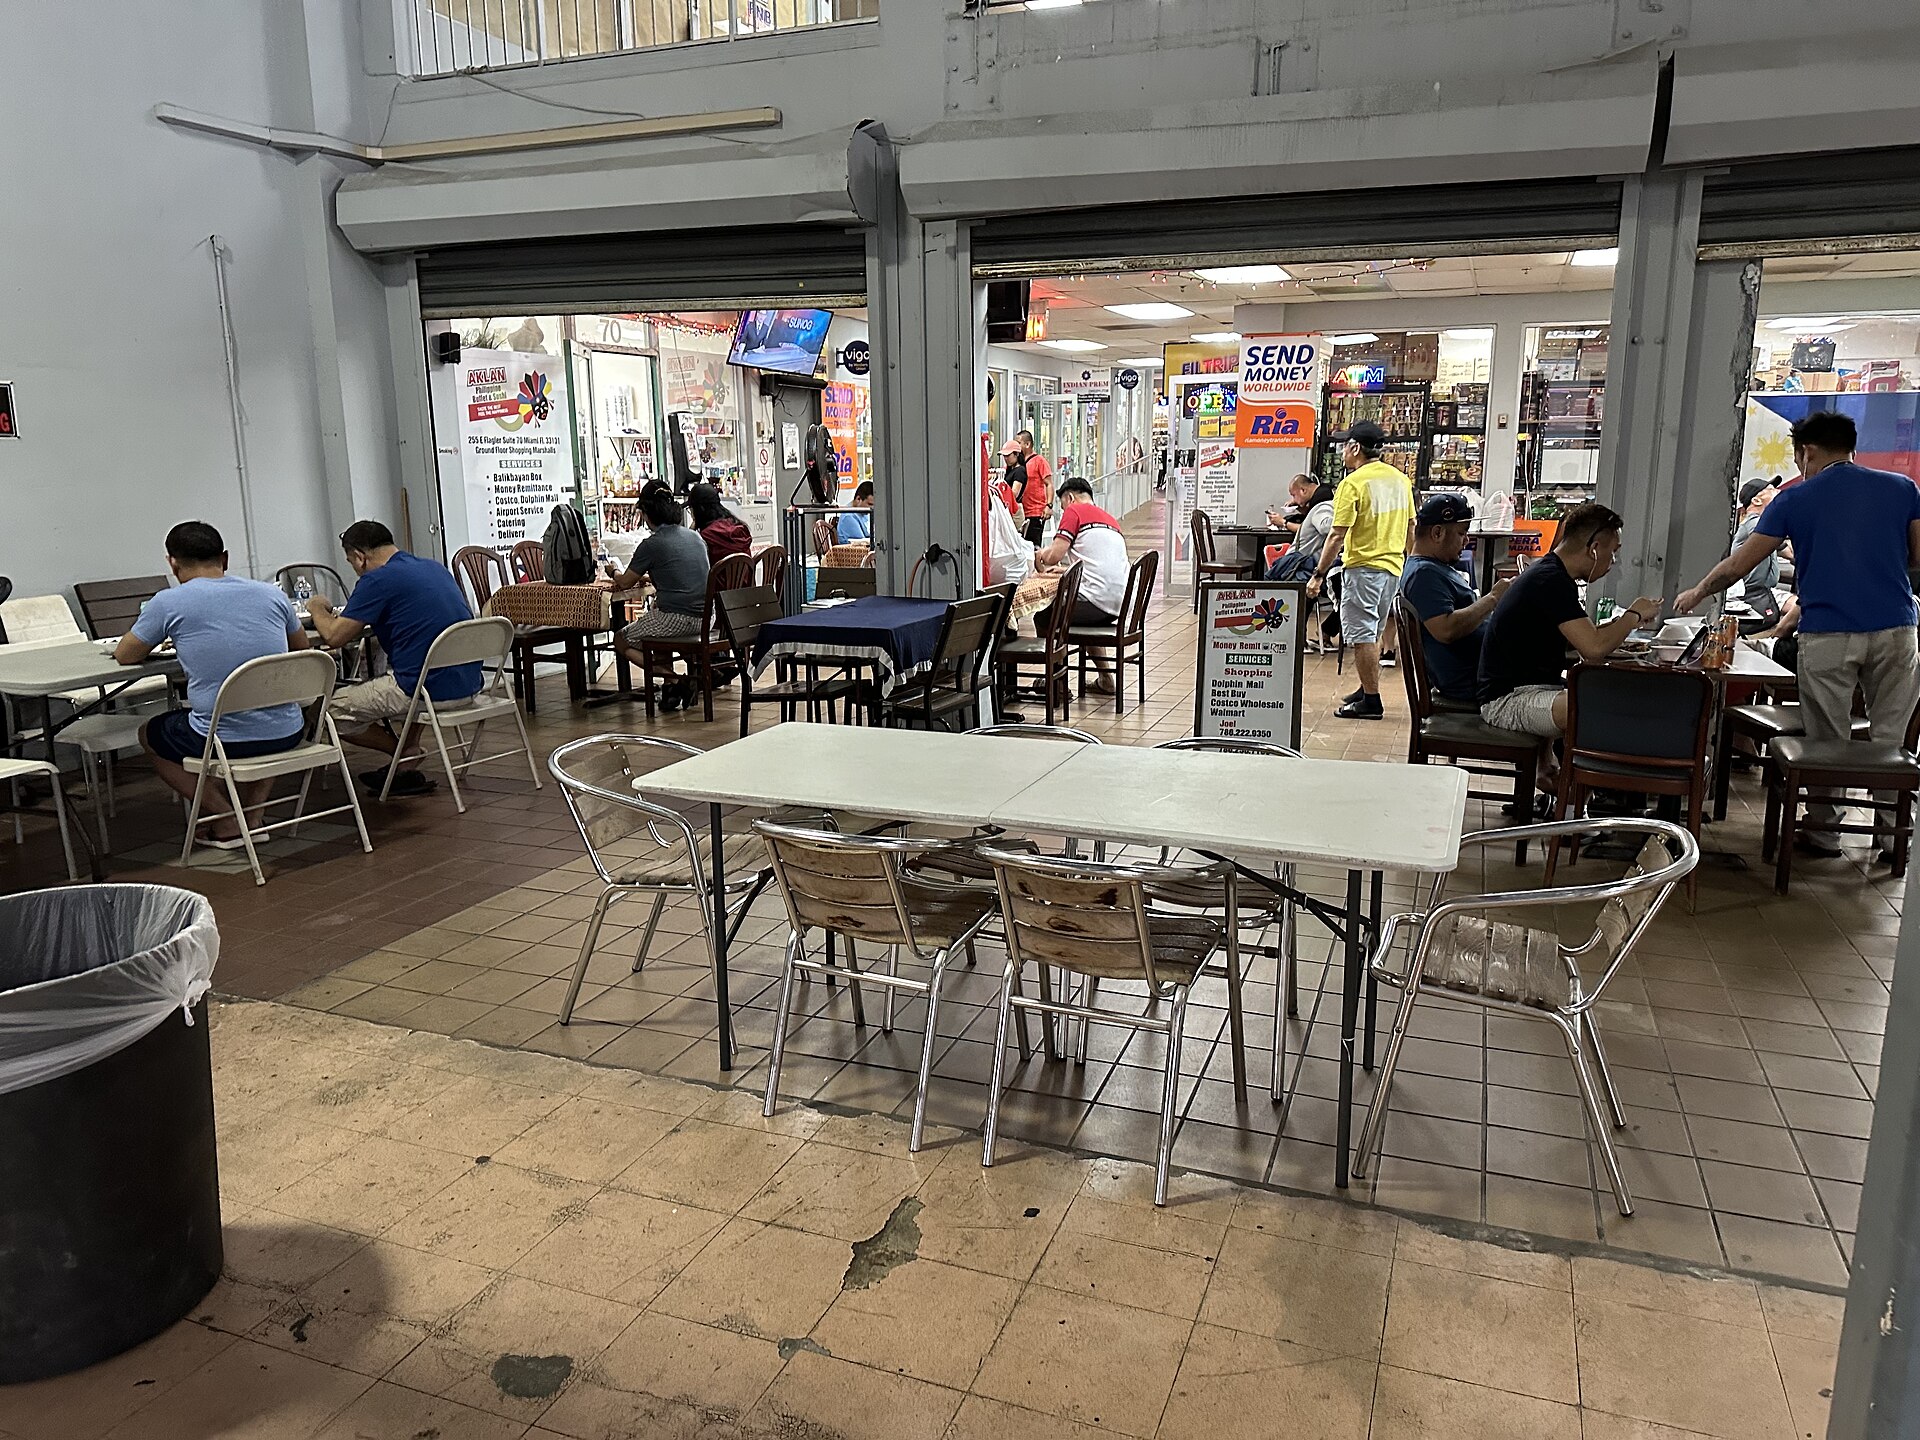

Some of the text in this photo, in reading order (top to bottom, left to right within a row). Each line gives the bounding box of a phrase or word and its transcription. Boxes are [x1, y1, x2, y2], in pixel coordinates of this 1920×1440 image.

[788, 317, 813, 330] SUNOG
[599, 318, 621, 343] 70
[1245, 344, 1314, 366] SEND
[468, 367, 507, 387] AKLAN
[1120, 373, 1138, 382] vigo
[1244, 366, 1313, 382] MONEY
[1332, 368, 1384, 383] ATM
[1244, 382, 1312, 392] WORLDWIDE
[825, 386, 853, 404] SEND
[1187, 393, 1237, 408] OPEN
[825, 406, 852, 418] MONEY
[1250, 408, 1299, 434] Ria
[468, 436, 479, 444] 255
[484, 436, 501, 445] Flagler
[503, 436, 516, 444] Suite
[509, 446, 532, 455] Shopping
[533, 446, 556, 454] Marshalls
[500, 460, 541, 468] SERVICES
[493, 472, 542, 482] Balikbayan Box
[494, 483, 552, 494] Money Remittance
[520, 495, 544, 504] Dolphin
[546, 494, 559, 502] Mall
[496, 506, 544, 516] Airport Service
[497, 518, 526, 528] Catering
[498, 530, 525, 539] Delivery
[1216, 590, 1255, 601] AKLAN
[1213, 641, 1236, 650] Money
[1228, 655, 1270, 664] SERVICES:
[1224, 668, 1272, 678] Shopping
[1212, 679, 1264, 689] Dolphin Mall
[1211, 689, 1246, 698] Best Buy
[1210, 699, 1284, 709] Costco Wholesale
[1210, 708, 1245, 717] Walmart
